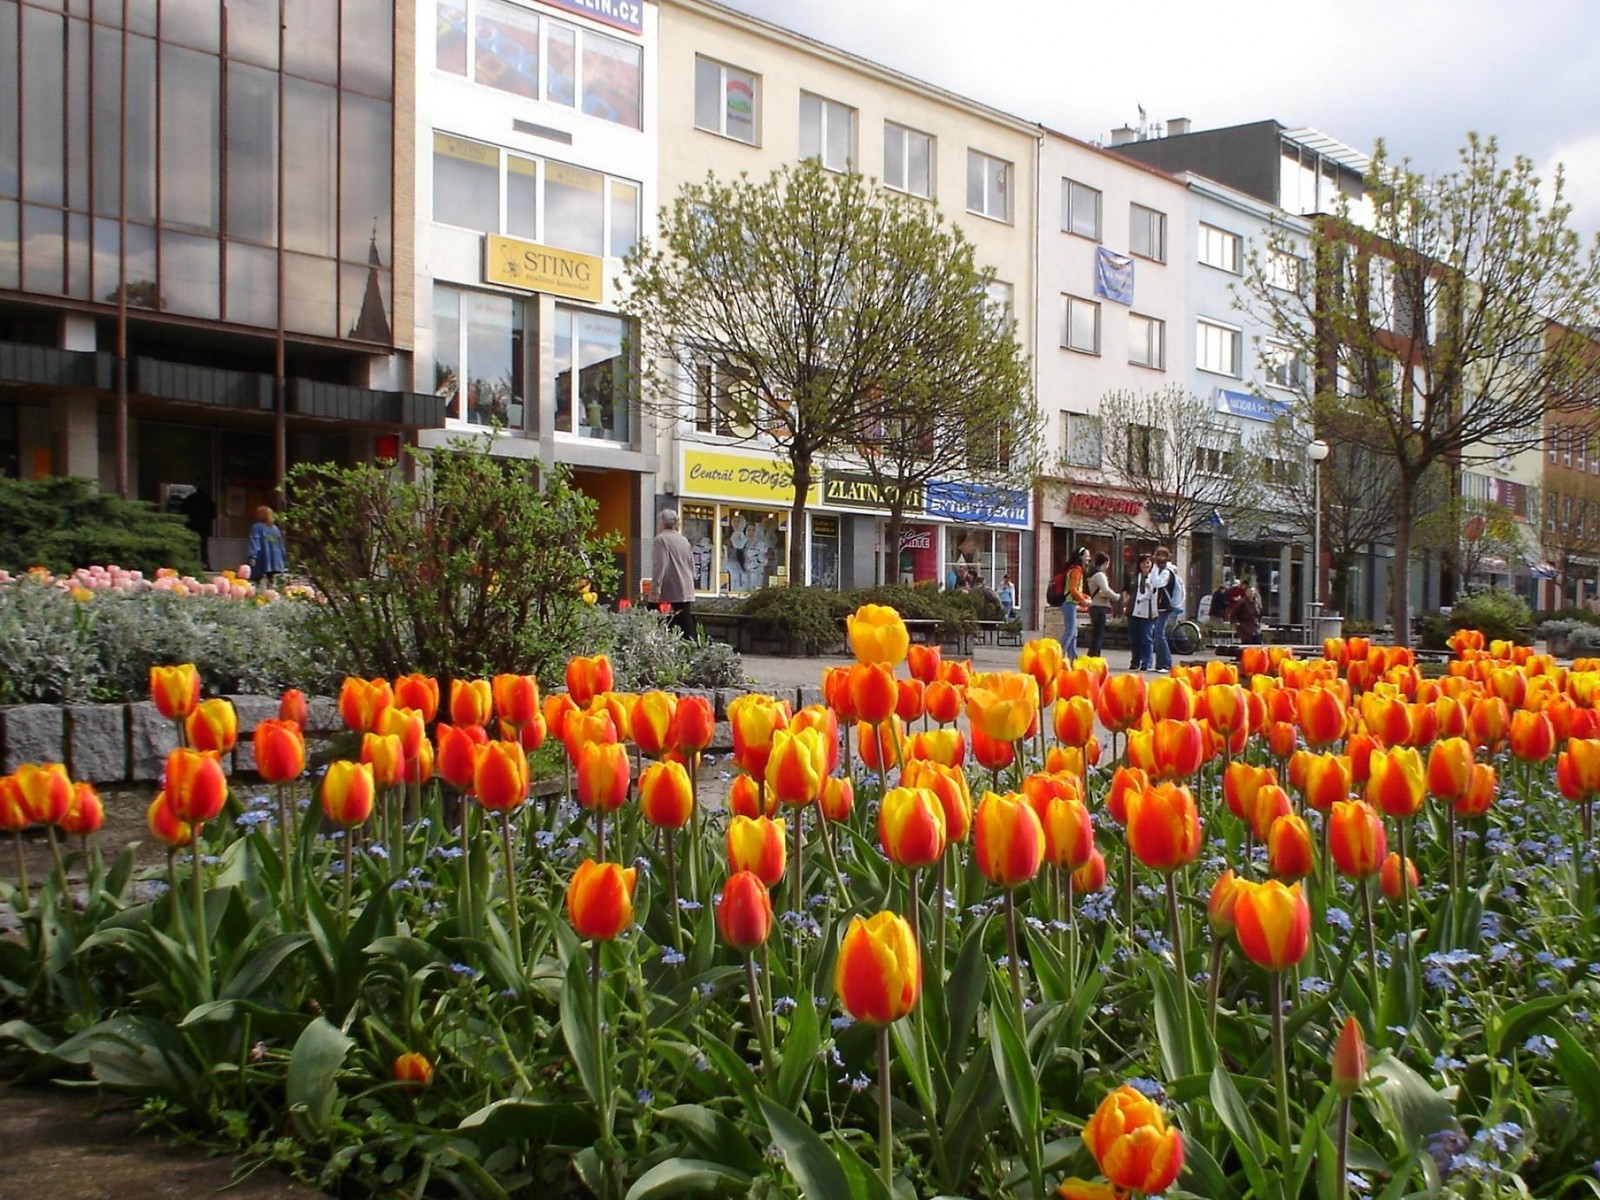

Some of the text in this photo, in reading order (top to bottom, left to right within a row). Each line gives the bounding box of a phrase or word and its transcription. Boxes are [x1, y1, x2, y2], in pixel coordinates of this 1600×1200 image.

[524, 251, 591, 281] STING
[690, 463, 815, 491] Centrál DROGE
